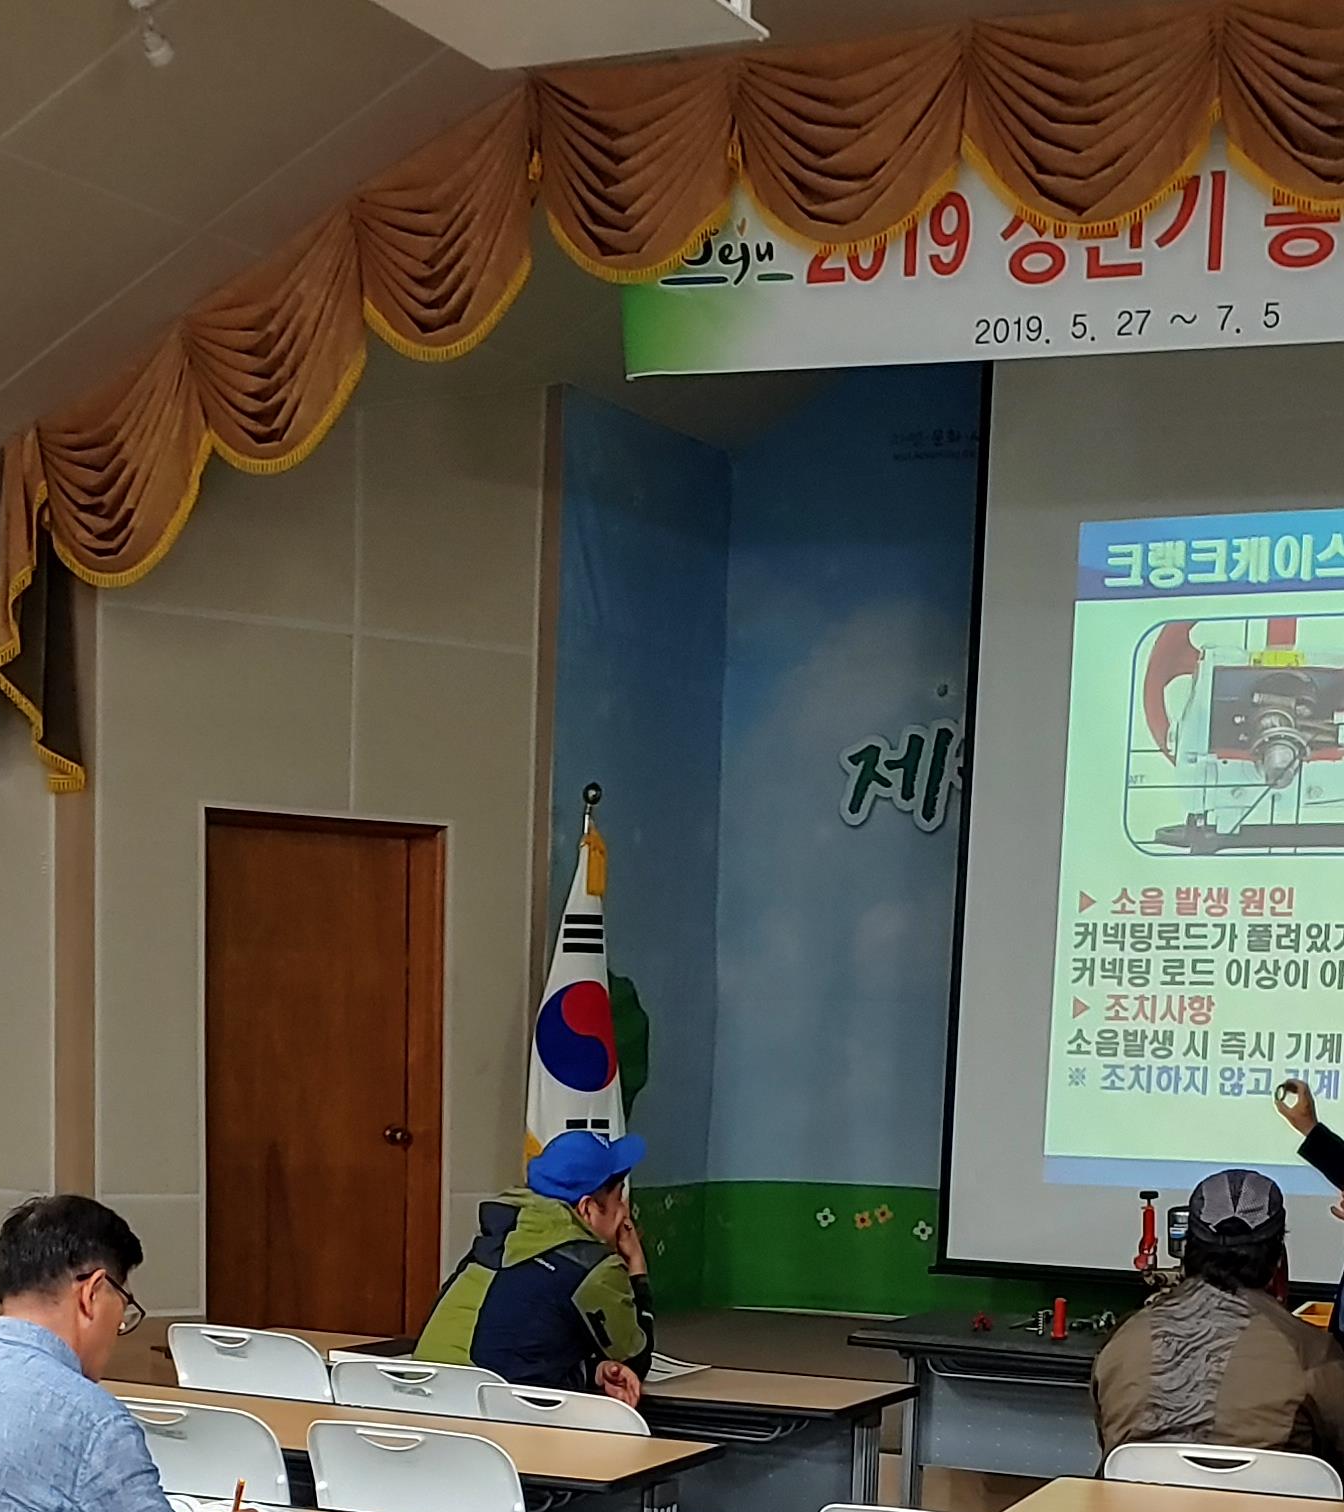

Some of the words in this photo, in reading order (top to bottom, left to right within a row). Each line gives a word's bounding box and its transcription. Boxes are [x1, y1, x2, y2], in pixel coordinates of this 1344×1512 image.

[974, 316, 1050, 346] 2019.
[1071, 313, 1094, 342] 5.
[1116, 309, 1151, 337] 27
[1216, 304, 1241, 334] 7.
[1263, 301, 1281, 329] 5
[1111, 886, 1164, 917] 소음
[1175, 886, 1229, 918] 발생
[1239, 886, 1295, 918] 원인
[1073, 922, 1238, 952] 커넥팅로드가
[1070, 956, 1152, 988] 커넥팅
[1160, 957, 1215, 987] 로드
[1225, 958, 1309, 990] 이상이
[1104, 993, 1215, 1026] 조치사항
[1066, 1028, 1174, 1060] 소음발생
[1182, 1029, 1209, 1061] 시
[1220, 1030, 1276, 1062] 즉시
[1100, 1064, 1209, 1096] 조치하지
[1219, 1066, 1273, 1098] 않고
